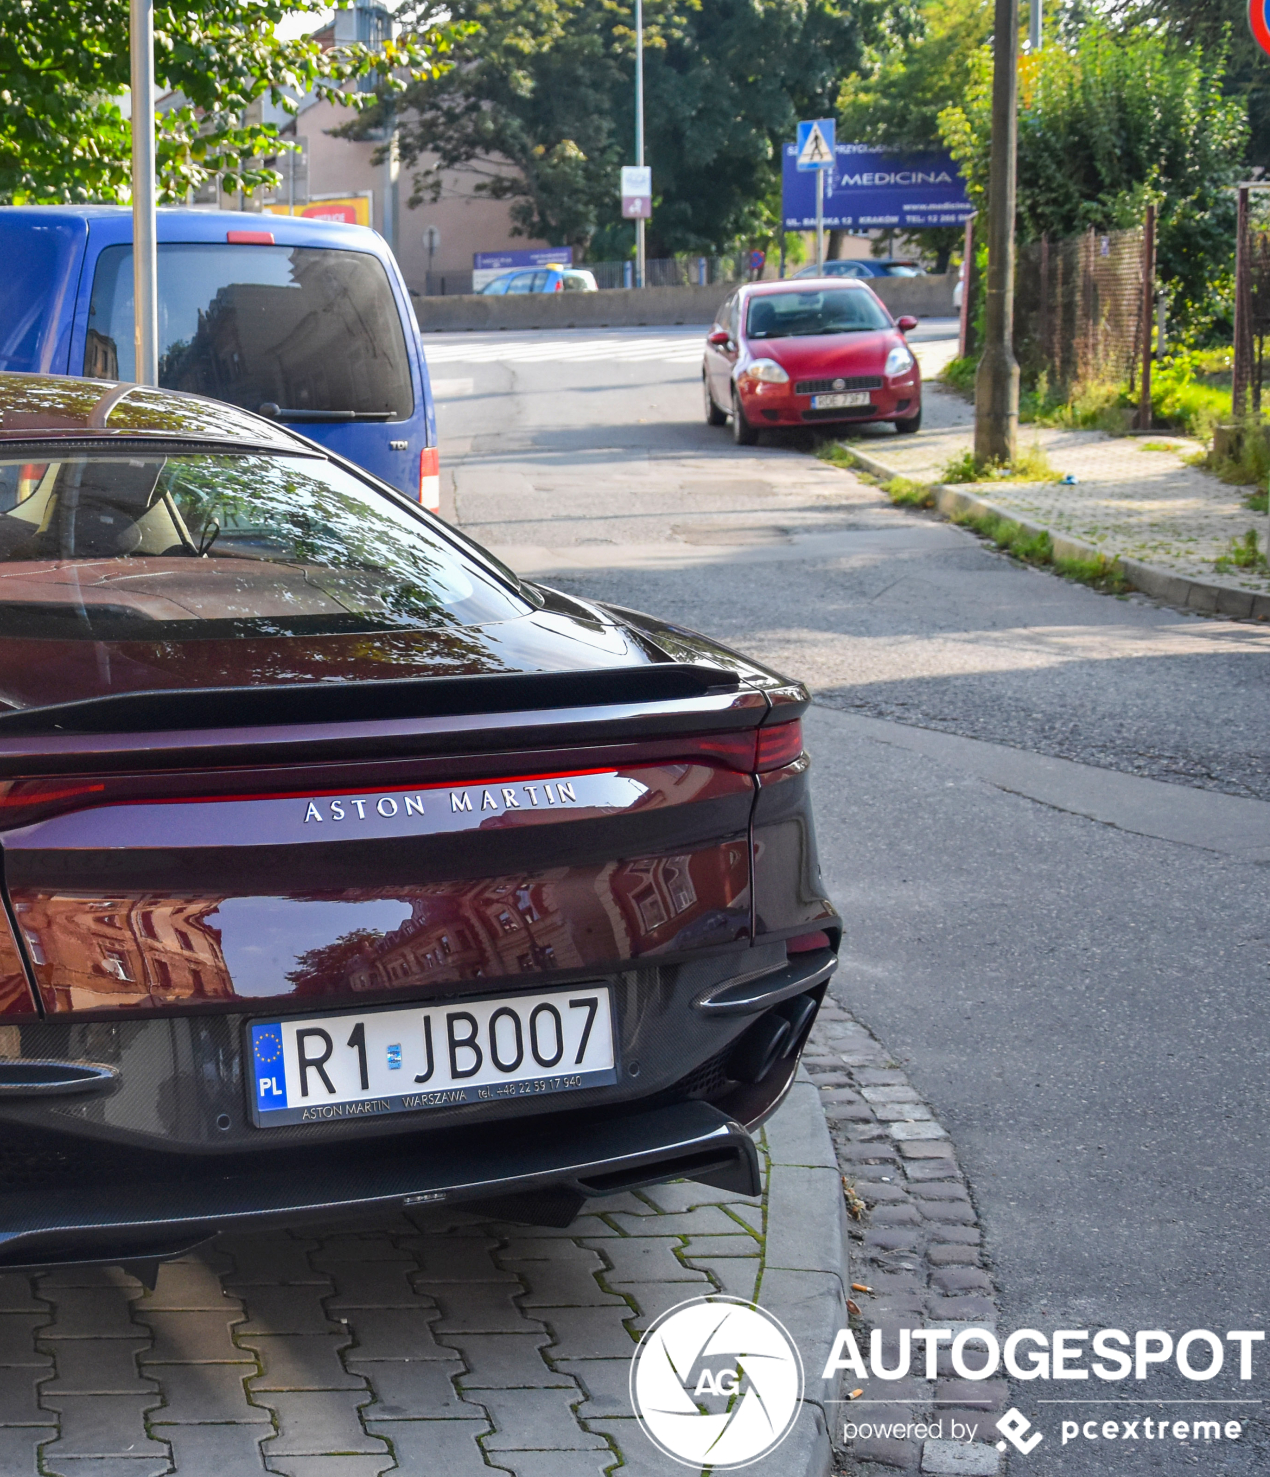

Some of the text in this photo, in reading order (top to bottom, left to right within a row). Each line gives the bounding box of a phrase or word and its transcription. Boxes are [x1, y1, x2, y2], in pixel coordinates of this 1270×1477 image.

[841, 171, 952, 186] MEDICINA
[390, 441, 408, 450] TDI
[303, 782, 577, 823] ASTON MARTIN
[295, 997, 599, 1097] R1 JB007
[259, 1078, 282, 1097] PL
[302, 1076, 582, 1120] ASTON MARTIN WARSZAWA tel. +48 22 59 17 940
